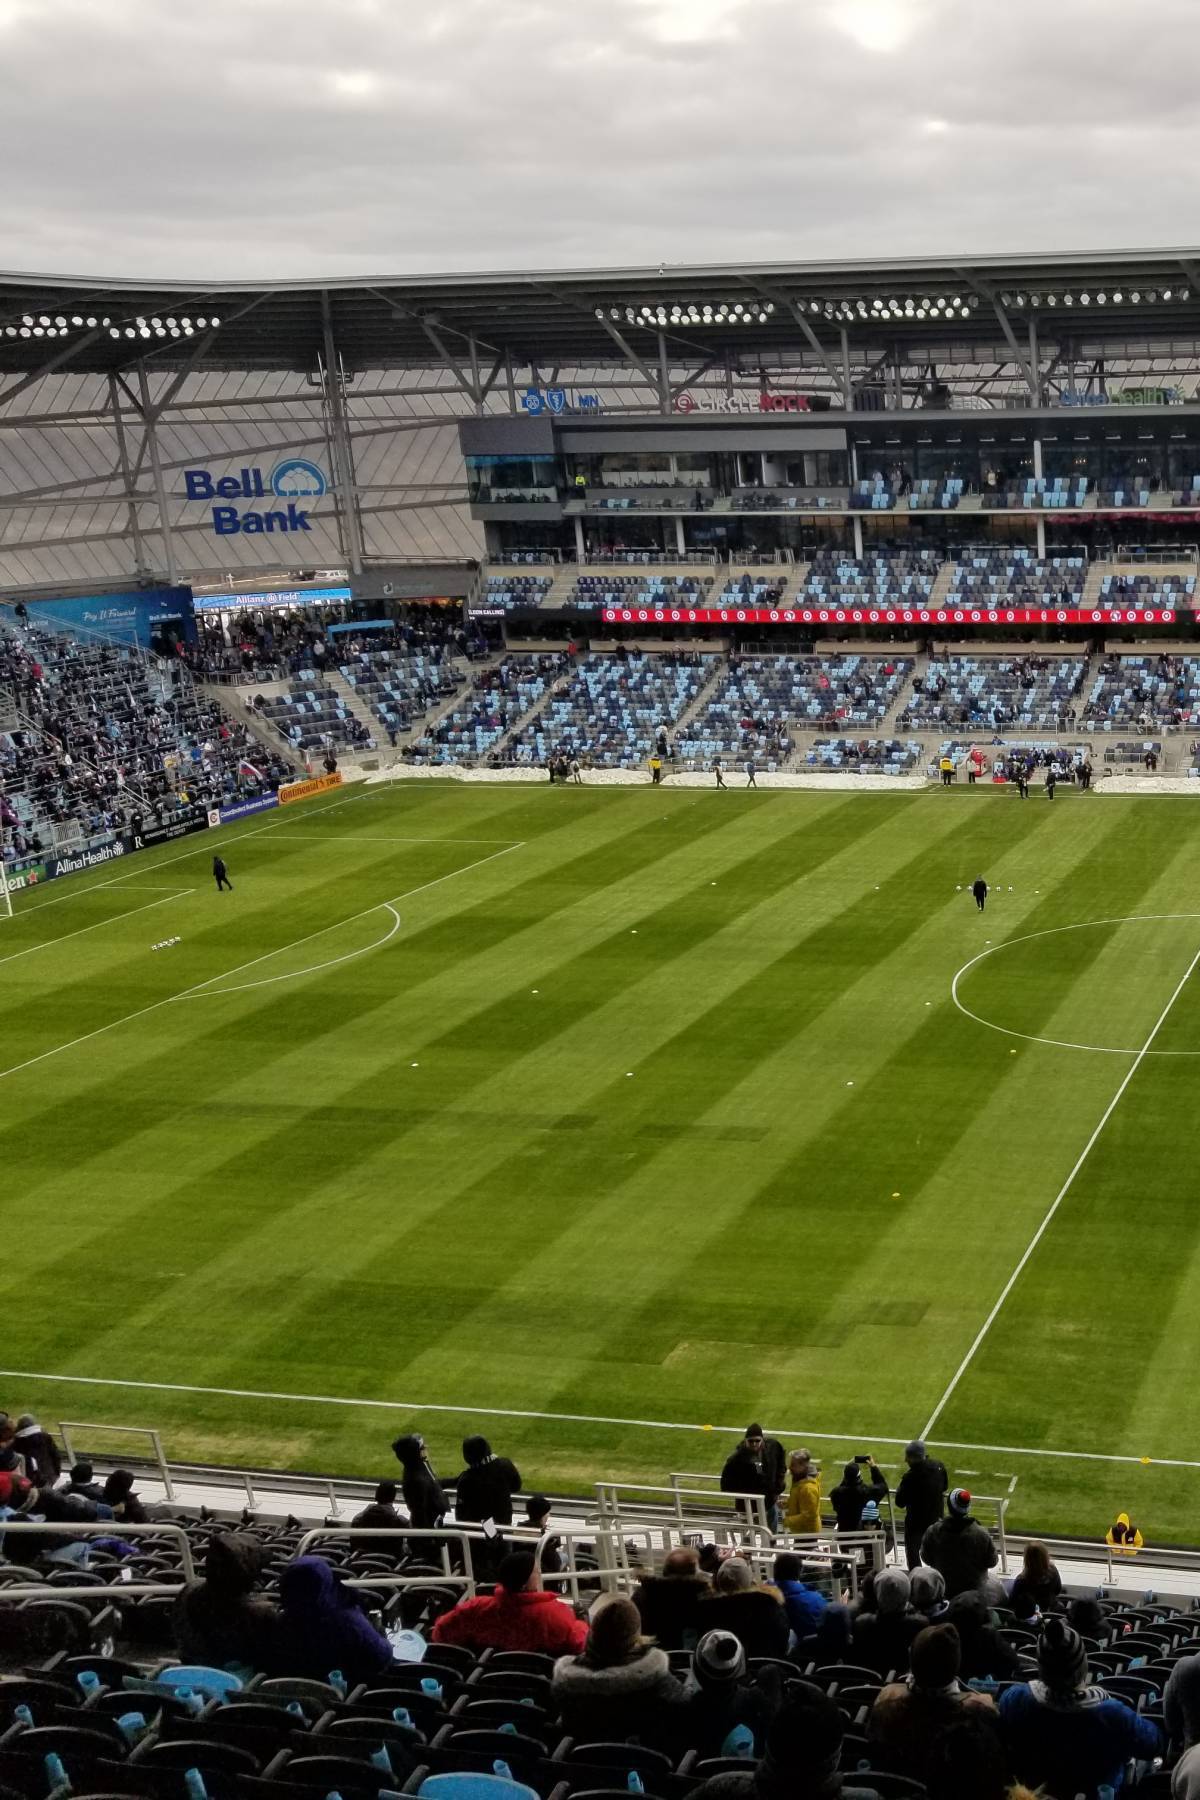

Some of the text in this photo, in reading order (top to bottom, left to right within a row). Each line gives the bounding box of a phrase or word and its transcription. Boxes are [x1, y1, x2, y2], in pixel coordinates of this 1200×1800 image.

[184, 468, 265, 500] Bell
[212, 503, 312, 535] Bank
[236, 591, 298, 604] Allianz Field
[281, 781, 318, 802] Continental
[135, 836, 144, 849] R
[56, 849, 113, 876] Allina Health
